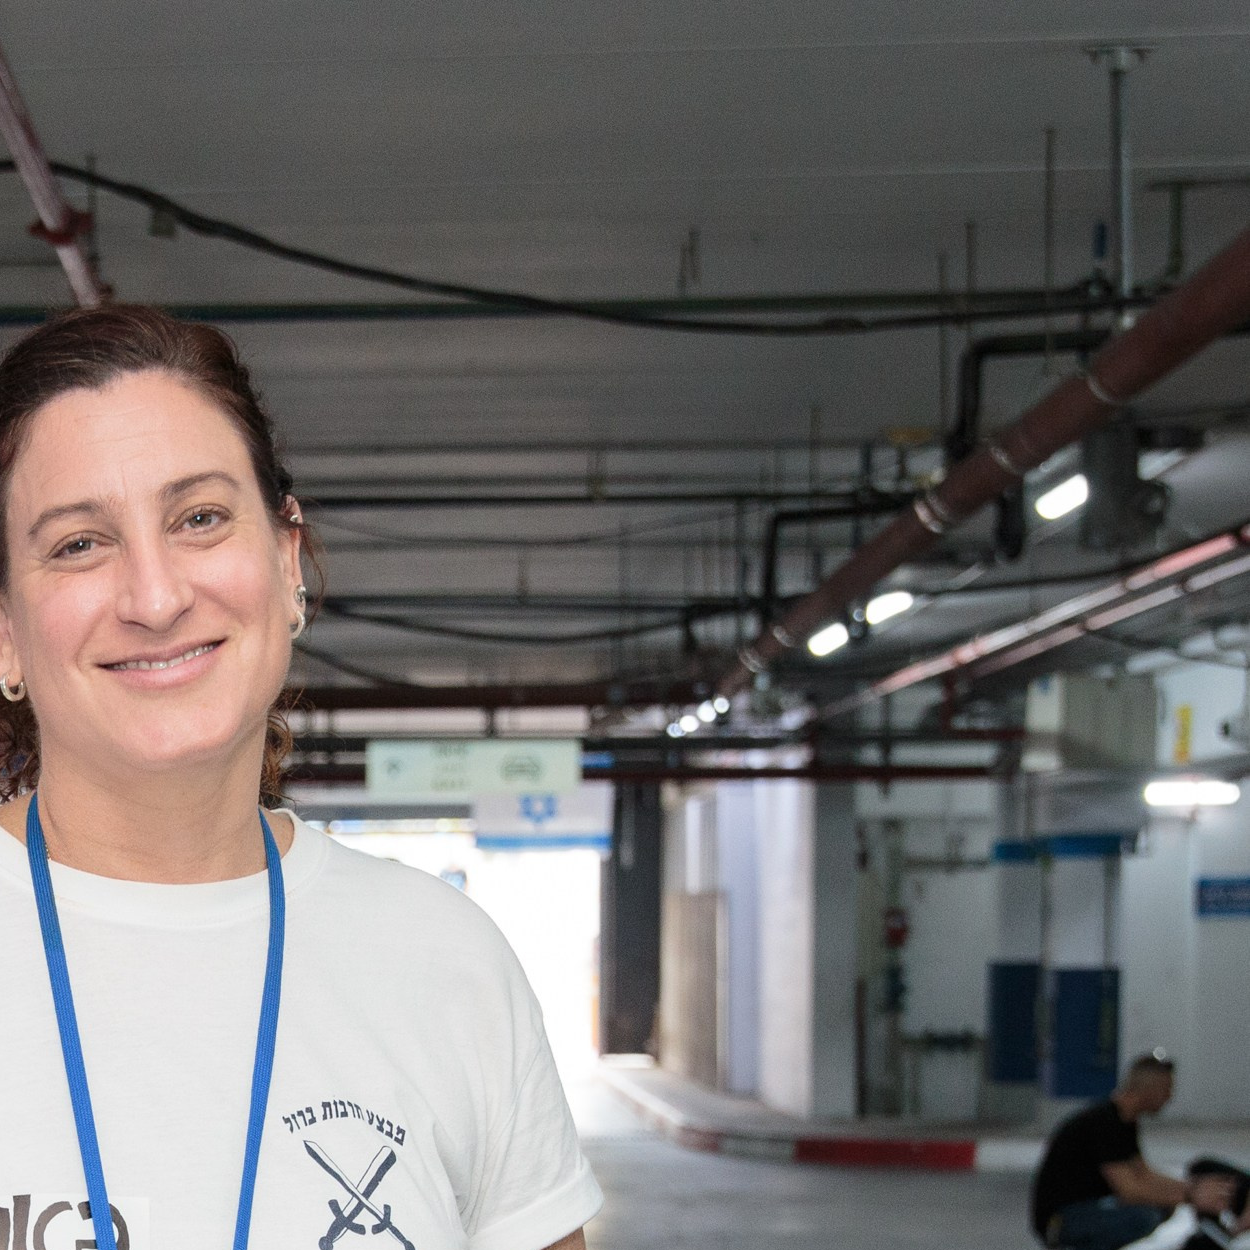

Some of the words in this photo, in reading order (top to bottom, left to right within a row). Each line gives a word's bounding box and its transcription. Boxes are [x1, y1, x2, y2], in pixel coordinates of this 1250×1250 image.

[282, 1107, 317, 1134] ברזל
[322, 1099, 365, 1121] חרבות
[366, 1109, 406, 1146] מבצע
